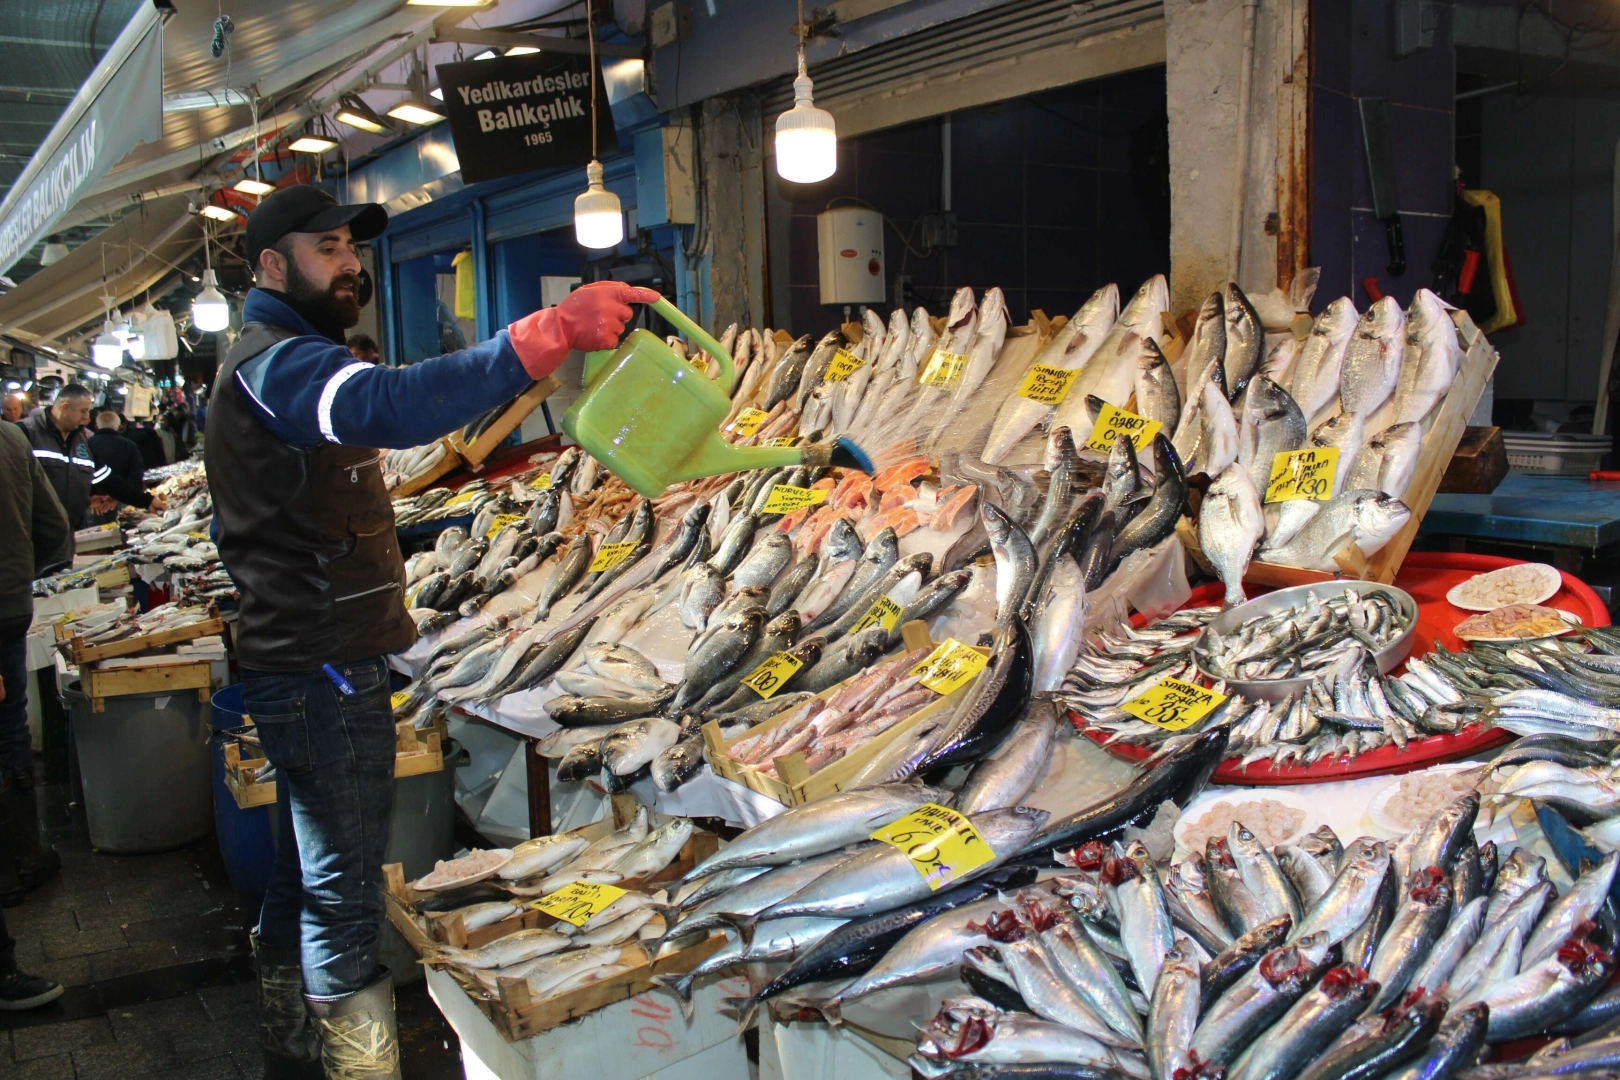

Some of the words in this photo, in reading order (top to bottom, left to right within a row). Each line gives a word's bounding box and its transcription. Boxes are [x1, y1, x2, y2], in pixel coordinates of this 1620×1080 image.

[457, 71, 590, 106] Yedikardeşler
[477, 96, 585, 133] Balıkçılık
[524, 131, 553, 147] 1965
[0, 198, 33, 266] RDEŞLER
[33, 119, 97, 230] BALIKÇILIK
[746, 669, 779, 691] 100
[1160, 680, 1213, 706] SARDALYA
